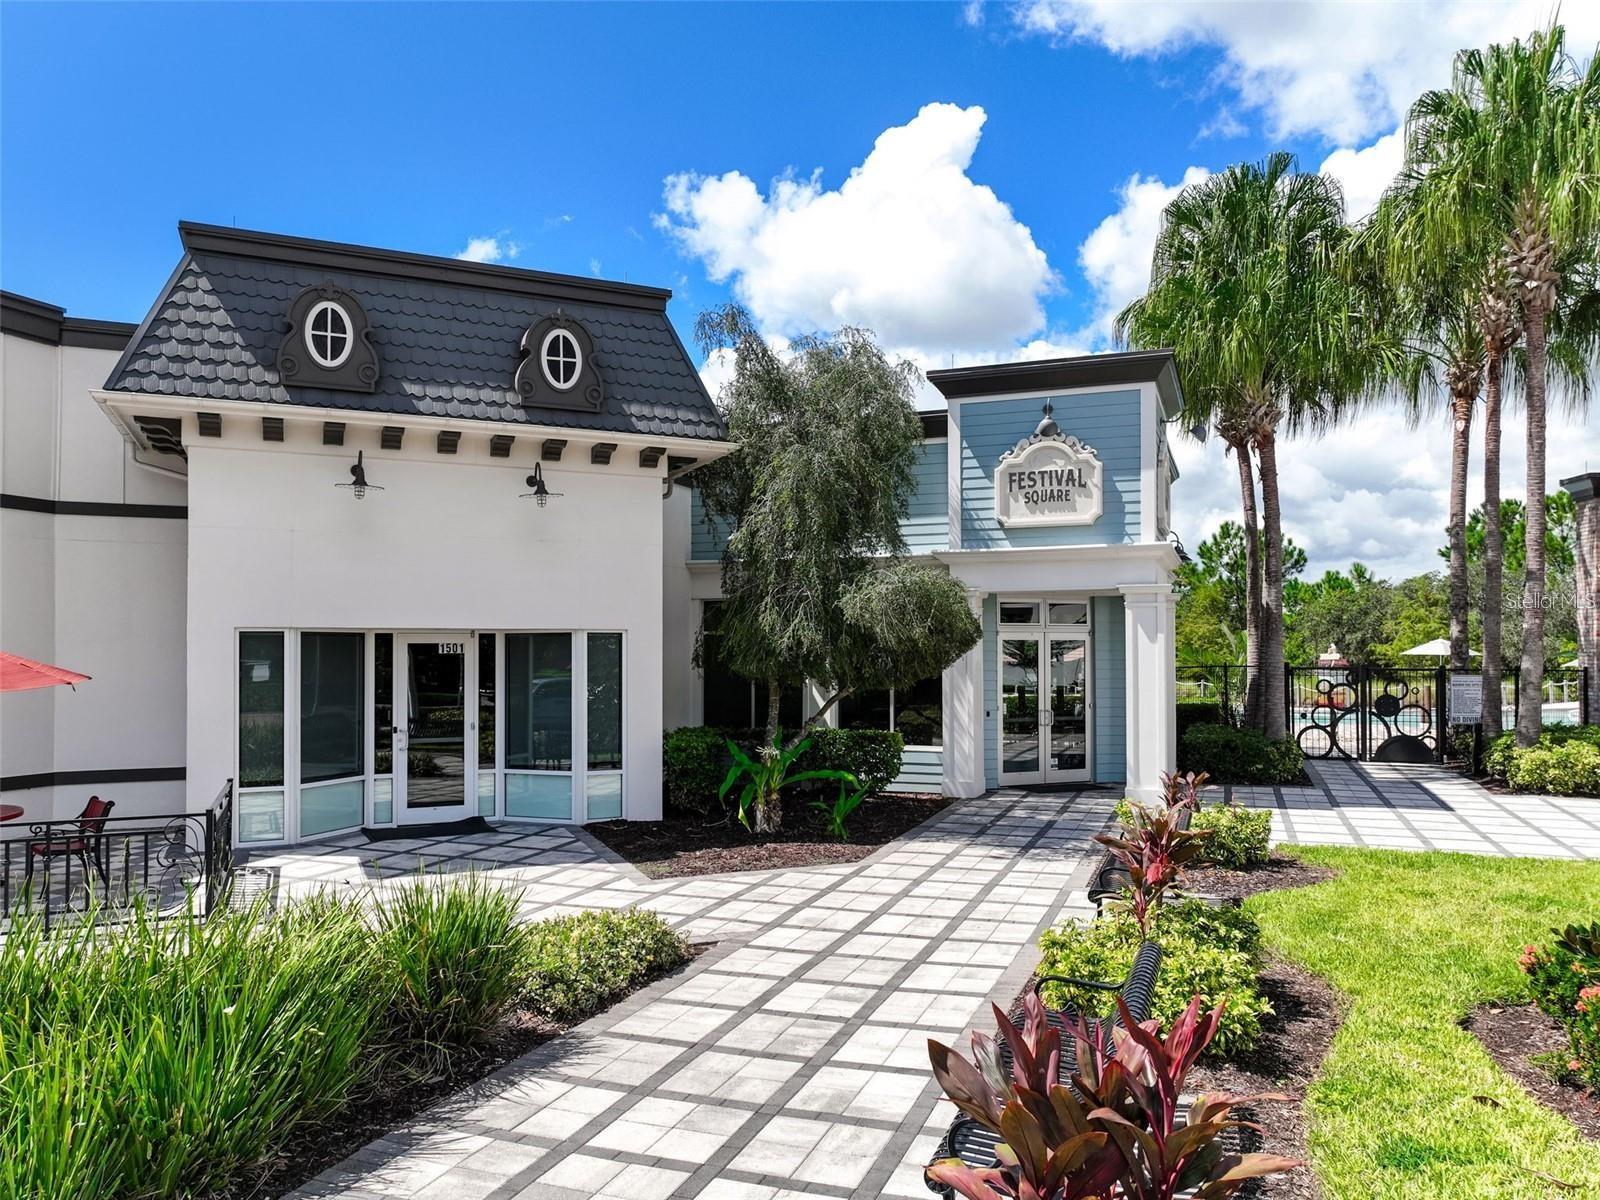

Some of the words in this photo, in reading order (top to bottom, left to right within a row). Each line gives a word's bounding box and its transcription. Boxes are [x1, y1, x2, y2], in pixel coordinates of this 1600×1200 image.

[1008, 468, 1087, 492] FESTIVAL
[1024, 489, 1071, 505] SQUARE
[440, 643, 464, 653] 1501
